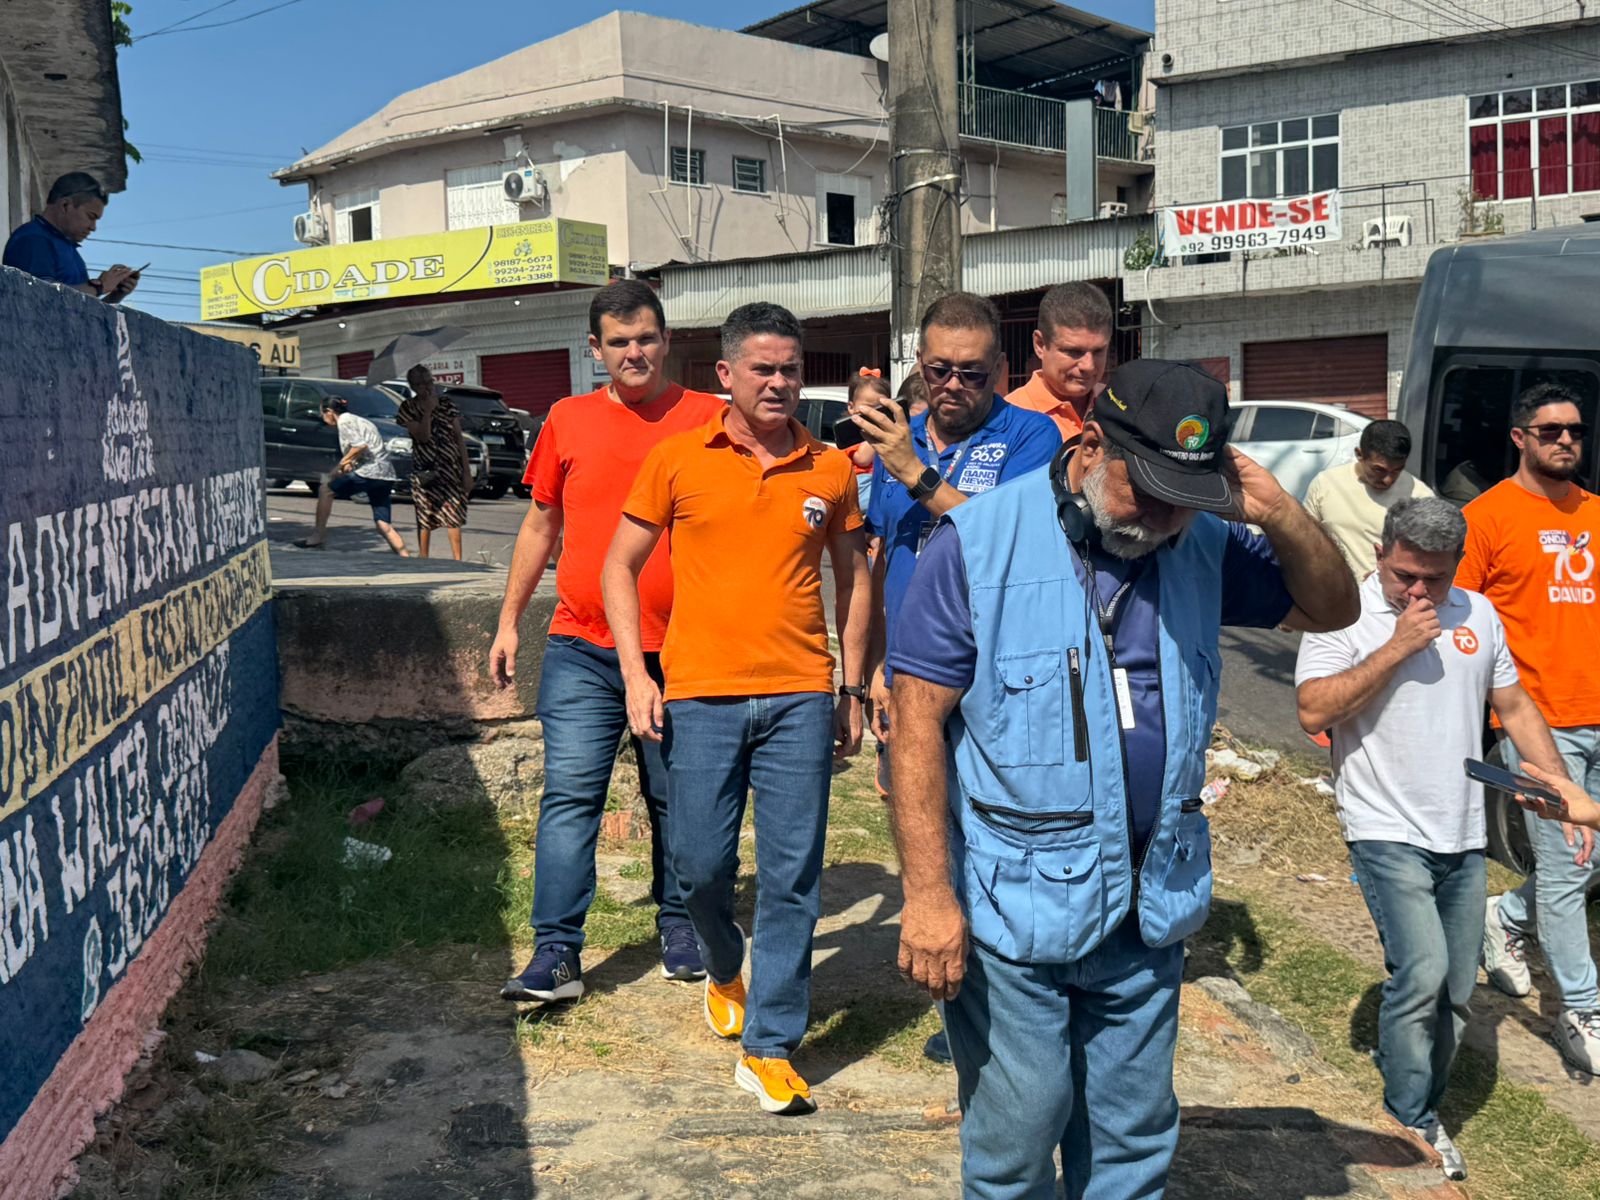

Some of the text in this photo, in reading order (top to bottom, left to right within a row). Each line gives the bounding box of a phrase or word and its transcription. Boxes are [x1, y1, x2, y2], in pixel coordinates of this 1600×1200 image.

[1175, 194, 1330, 236] VENDE-SE
[1188, 225, 1327, 253] 92 99963-7949
[493, 254, 553, 267] 98187-6673
[494, 264, 553, 276] 99294-2274
[494, 272, 553, 284] 3624-3388
[970, 449, 1005, 463] 96.9
[961, 477, 994, 487] NEWS
[964, 470, 996, 480] BAND
[1539, 535, 1568, 546] ONDA
[1541, 544, 1596, 583] 70
[1547, 585, 1597, 605] DAVID
[1454, 634, 1477, 651] 70
[51, 719, 151, 914] WALTER
